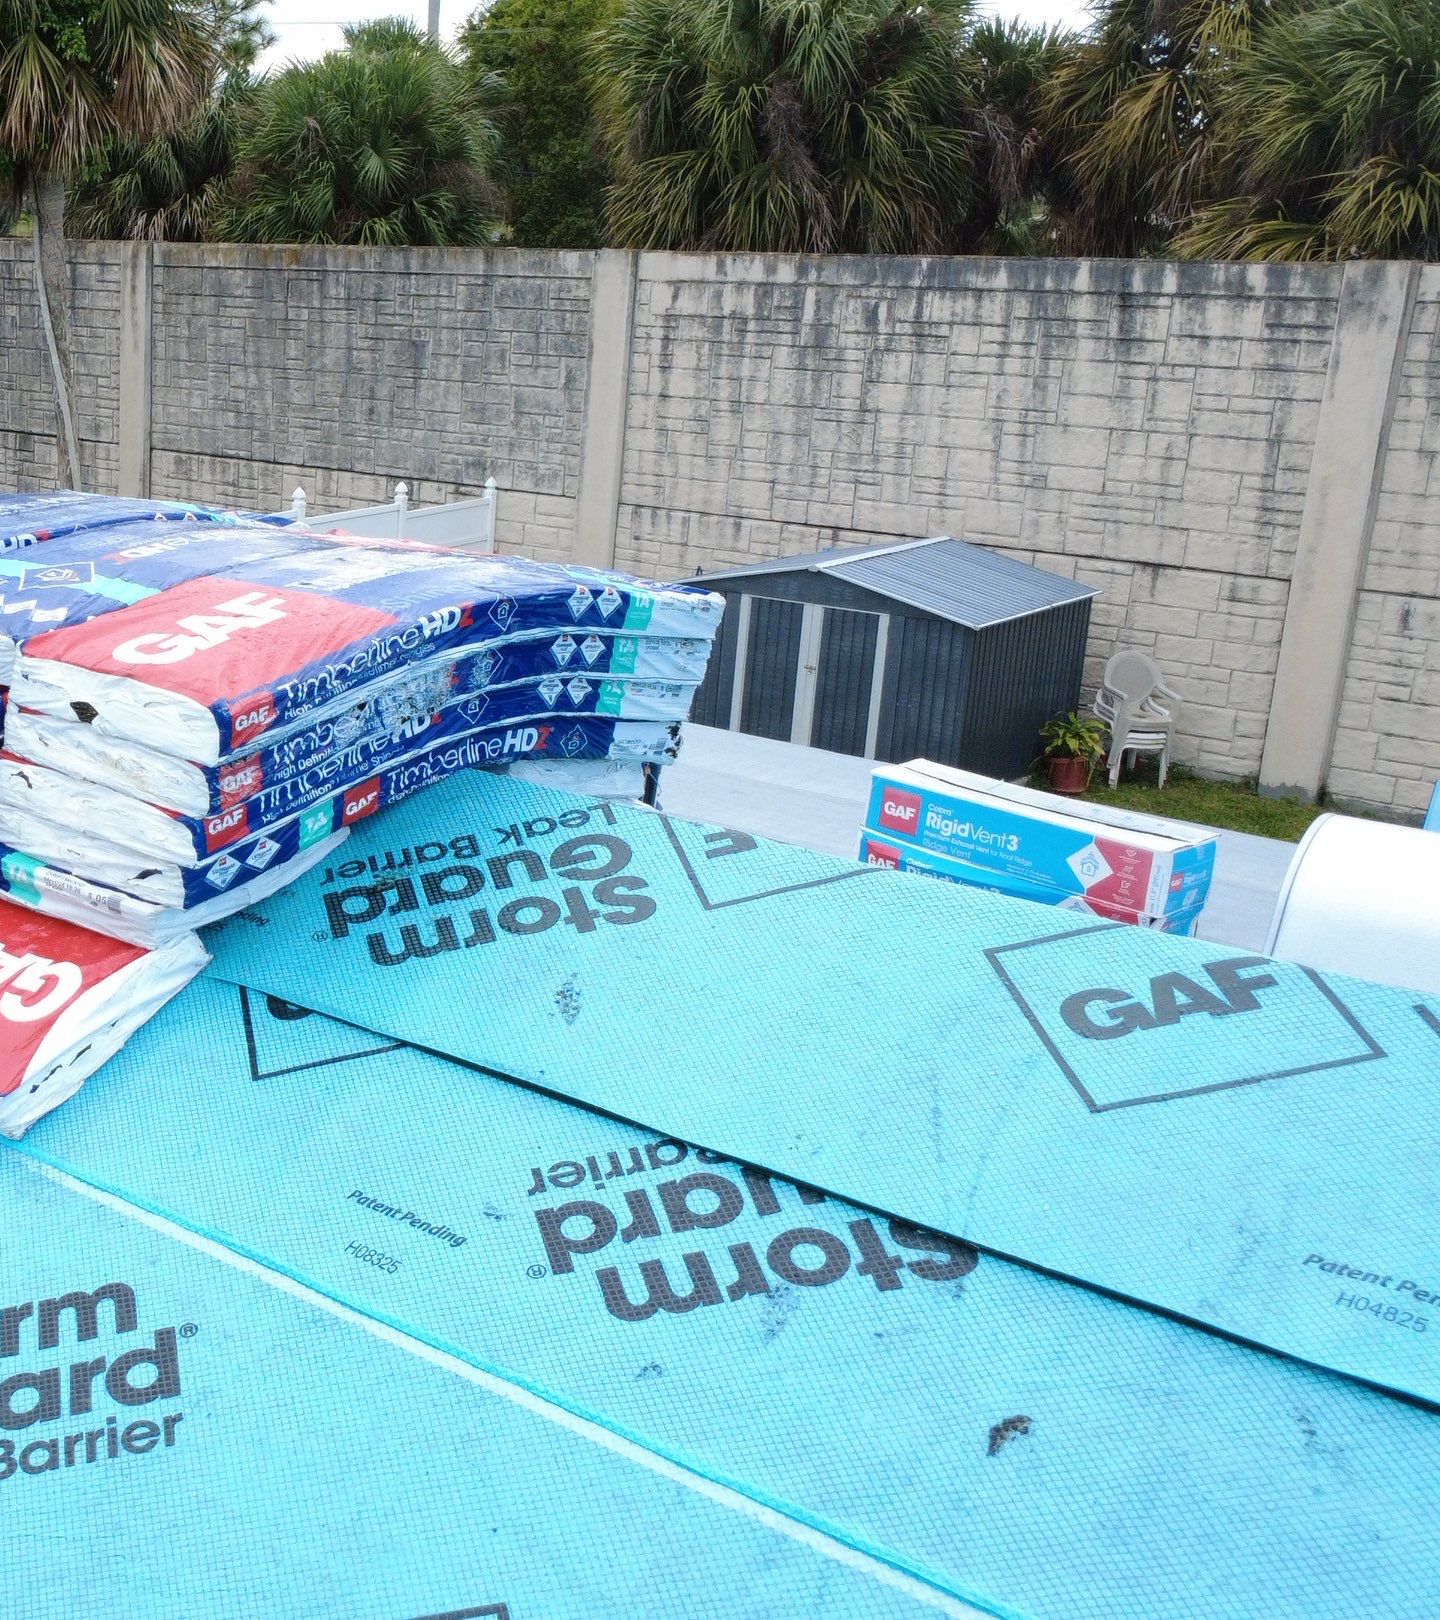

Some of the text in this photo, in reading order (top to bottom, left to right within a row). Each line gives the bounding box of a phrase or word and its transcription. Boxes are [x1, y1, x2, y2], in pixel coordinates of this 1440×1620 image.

[112, 591, 288, 666] GAF
[235, 704, 273, 731] GAF
[208, 809, 244, 835] GAF
[345, 791, 378, 816] GAF
[884, 801, 917, 820] GAF
[323, 801, 618, 886] Leak Barrier
[922, 838, 948, 853] Ridge
[366, 874, 657, 967] Storm
[1058, 957, 1279, 1041] GAF
[347, 1189, 468, 1248] Patent Pending
[532, 1164, 829, 1276] uard
[344, 1240, 403, 1274] H08325
[596, 1217, 979, 1323] Storm
[1302, 1252, 1394, 1292] Patent
[1335, 1291, 1429, 1335] H04825
